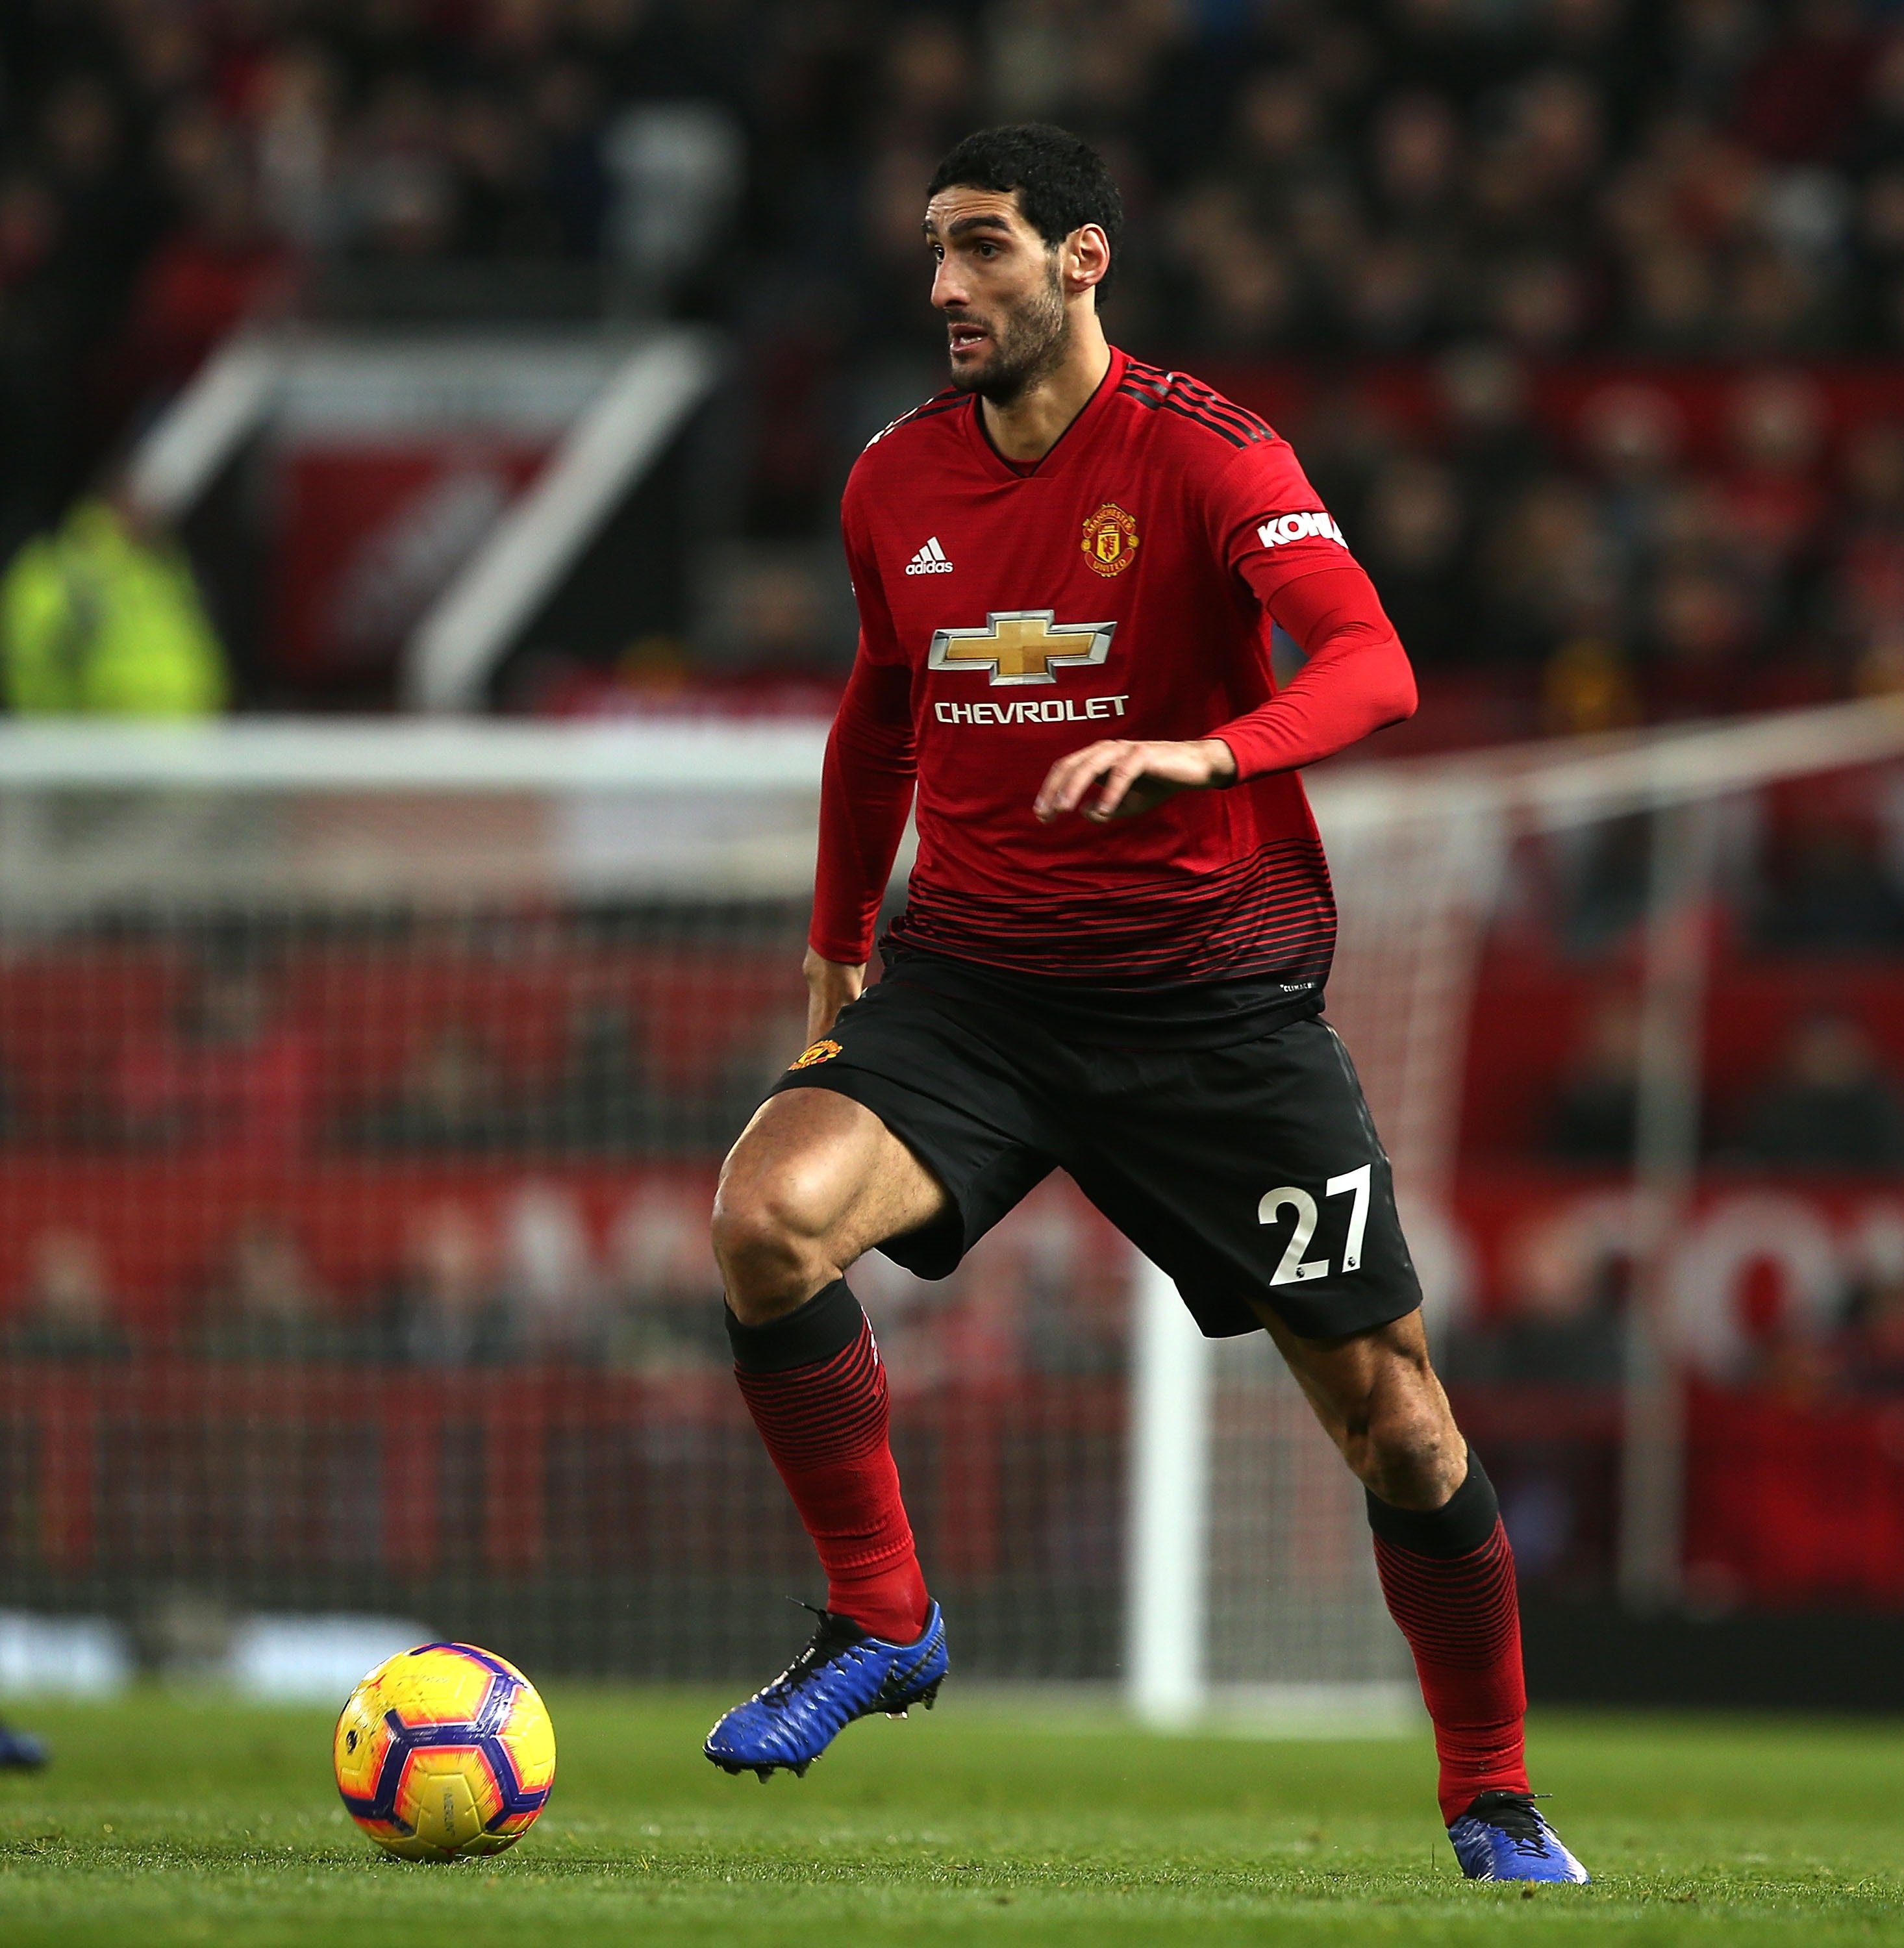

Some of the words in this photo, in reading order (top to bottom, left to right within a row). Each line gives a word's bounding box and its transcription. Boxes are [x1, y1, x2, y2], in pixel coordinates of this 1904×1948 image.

[905, 560, 953, 575] adidas
[1092, 558, 1127, 572] UNITED
[934, 695, 1129, 724] CHEVROLET
[1258, 1164, 1371, 1286] 27
